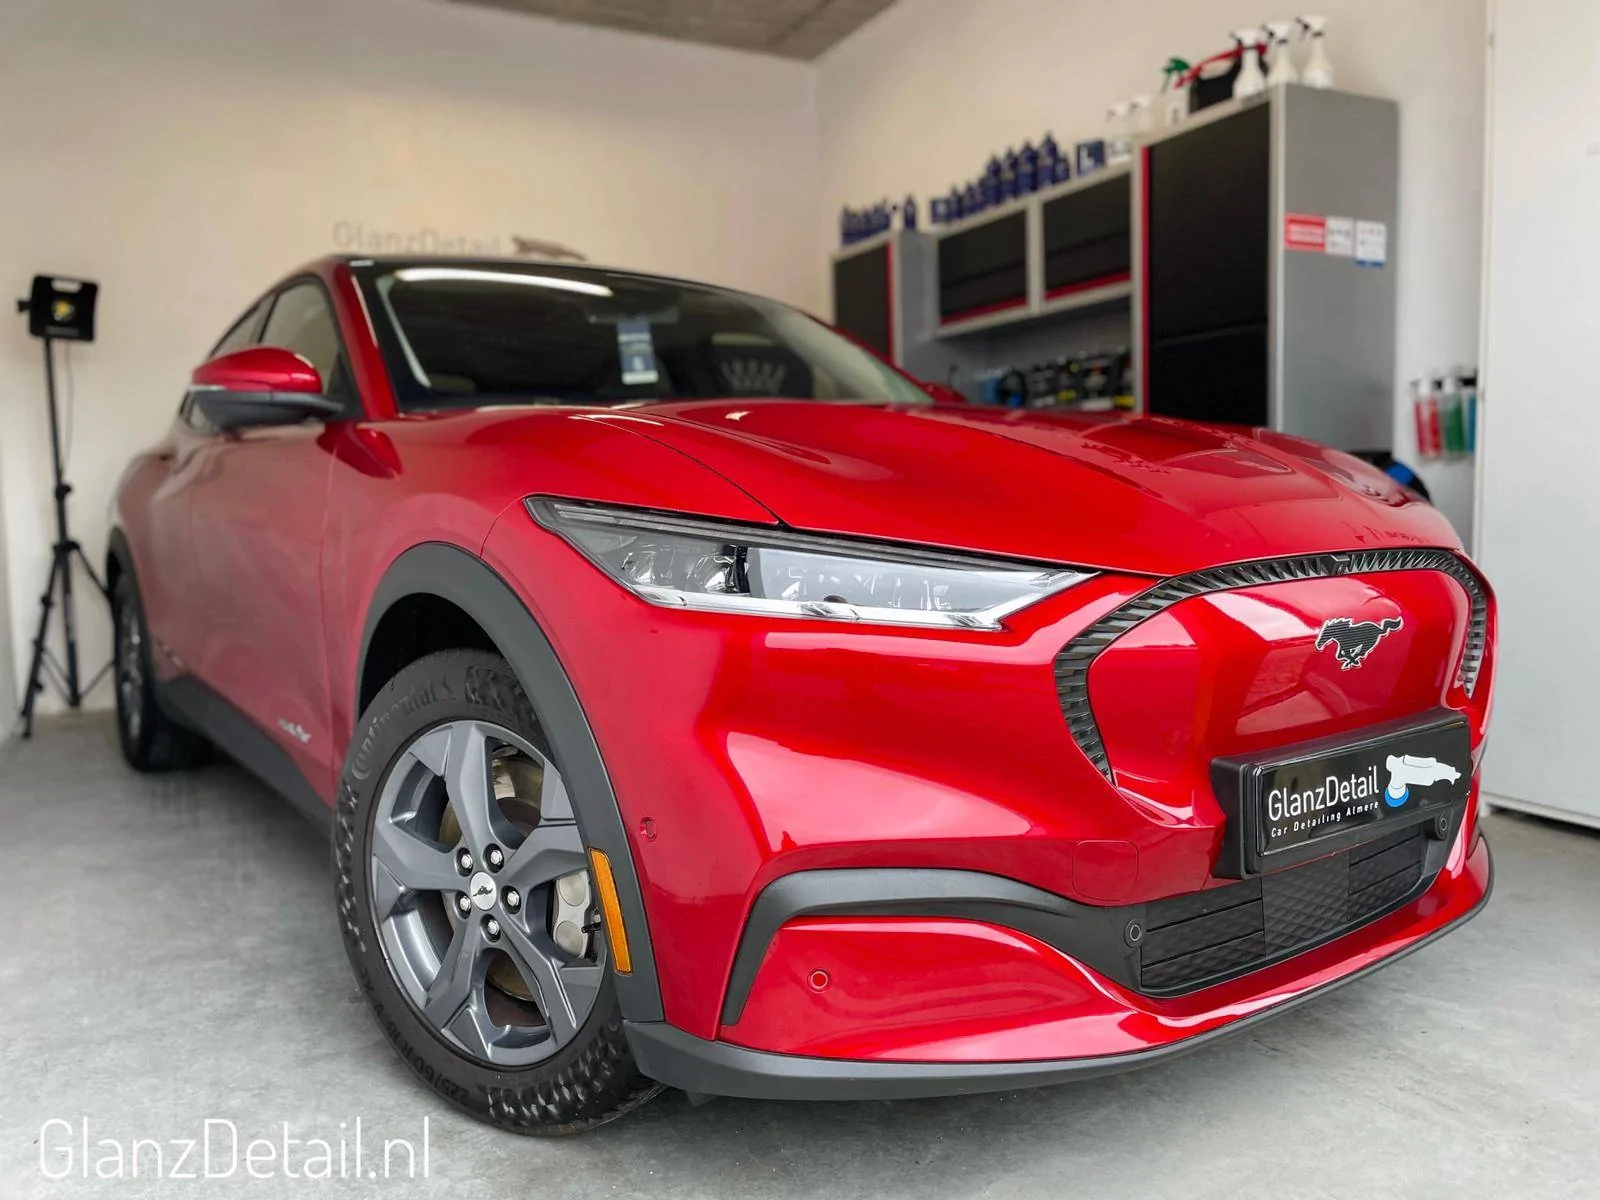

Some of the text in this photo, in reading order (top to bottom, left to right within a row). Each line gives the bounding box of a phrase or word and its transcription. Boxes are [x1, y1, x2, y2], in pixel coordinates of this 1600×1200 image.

[1268, 765, 1379, 821] GlanzDetail
[1271, 801, 1379, 838] Car Detailing Almere
[415, 1057, 469, 1106] 225/60
